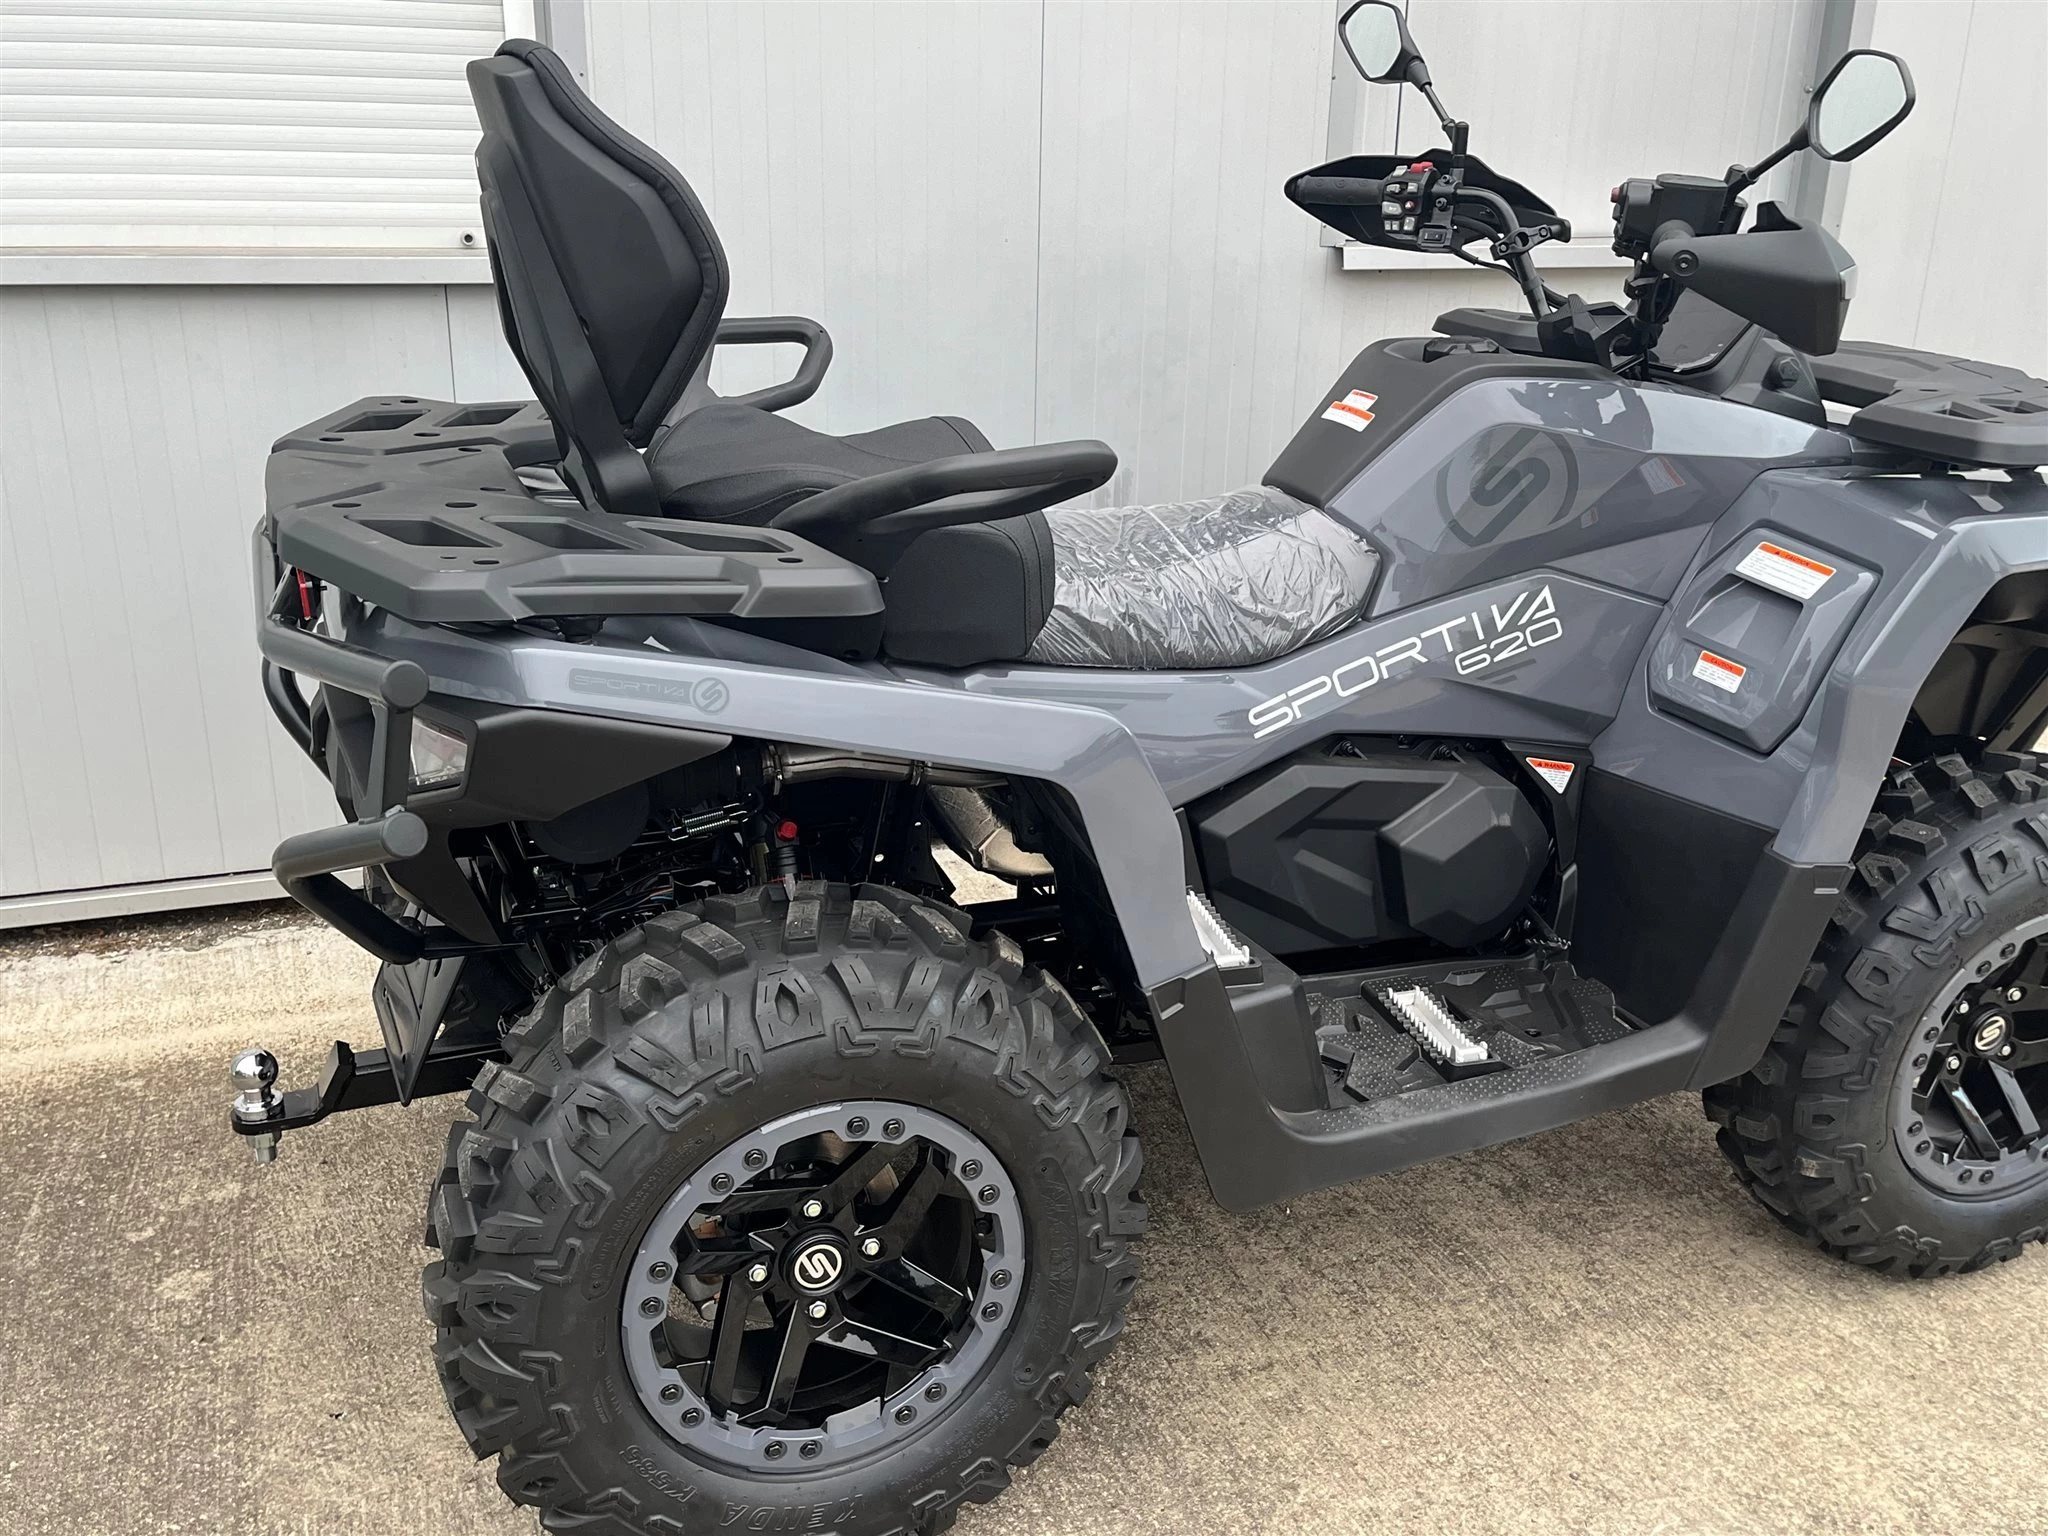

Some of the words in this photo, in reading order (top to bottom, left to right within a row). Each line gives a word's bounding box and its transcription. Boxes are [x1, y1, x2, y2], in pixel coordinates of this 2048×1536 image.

[1248, 585, 1556, 740] SPORTIVA
[1455, 617, 1563, 676] 620
[574, 674, 684, 697] SPORTIVA
[1544, 761, 1570, 771] WARNING
[619, 1444, 698, 1503] K585
[719, 1493, 863, 1531] KENDA
